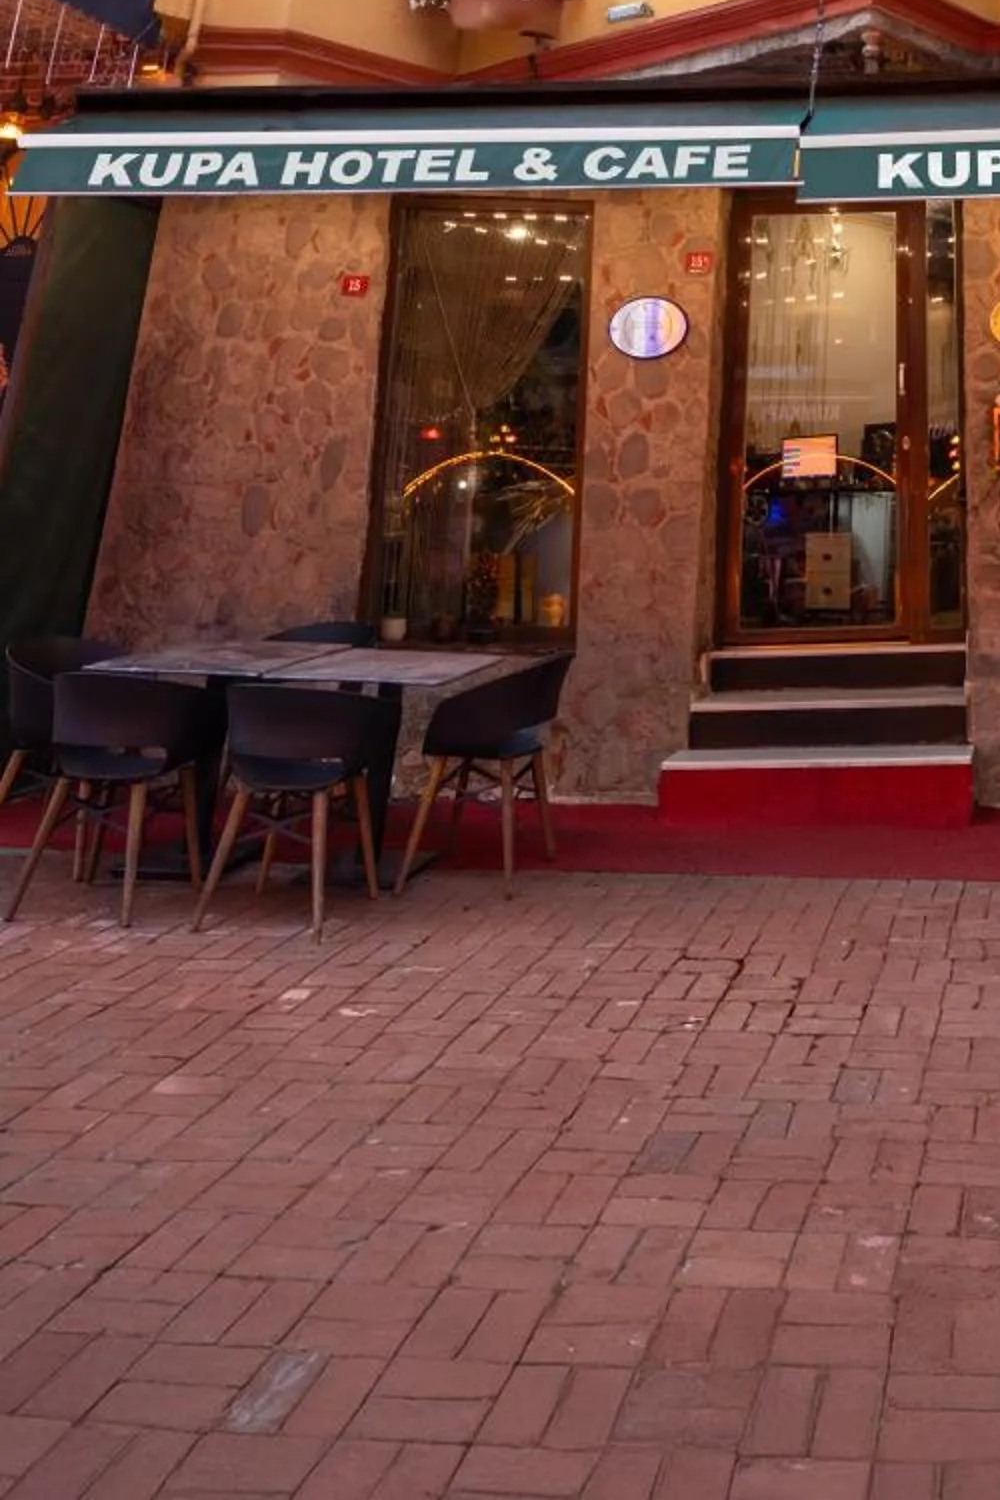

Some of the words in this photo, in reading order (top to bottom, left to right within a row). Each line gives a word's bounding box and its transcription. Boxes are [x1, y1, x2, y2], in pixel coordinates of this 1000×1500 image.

[88, 153, 258, 186] KUPA
[281, 149, 489, 184] HOTEL
[514, 148, 557, 180] &
[584, 145, 750, 180] CAFE
